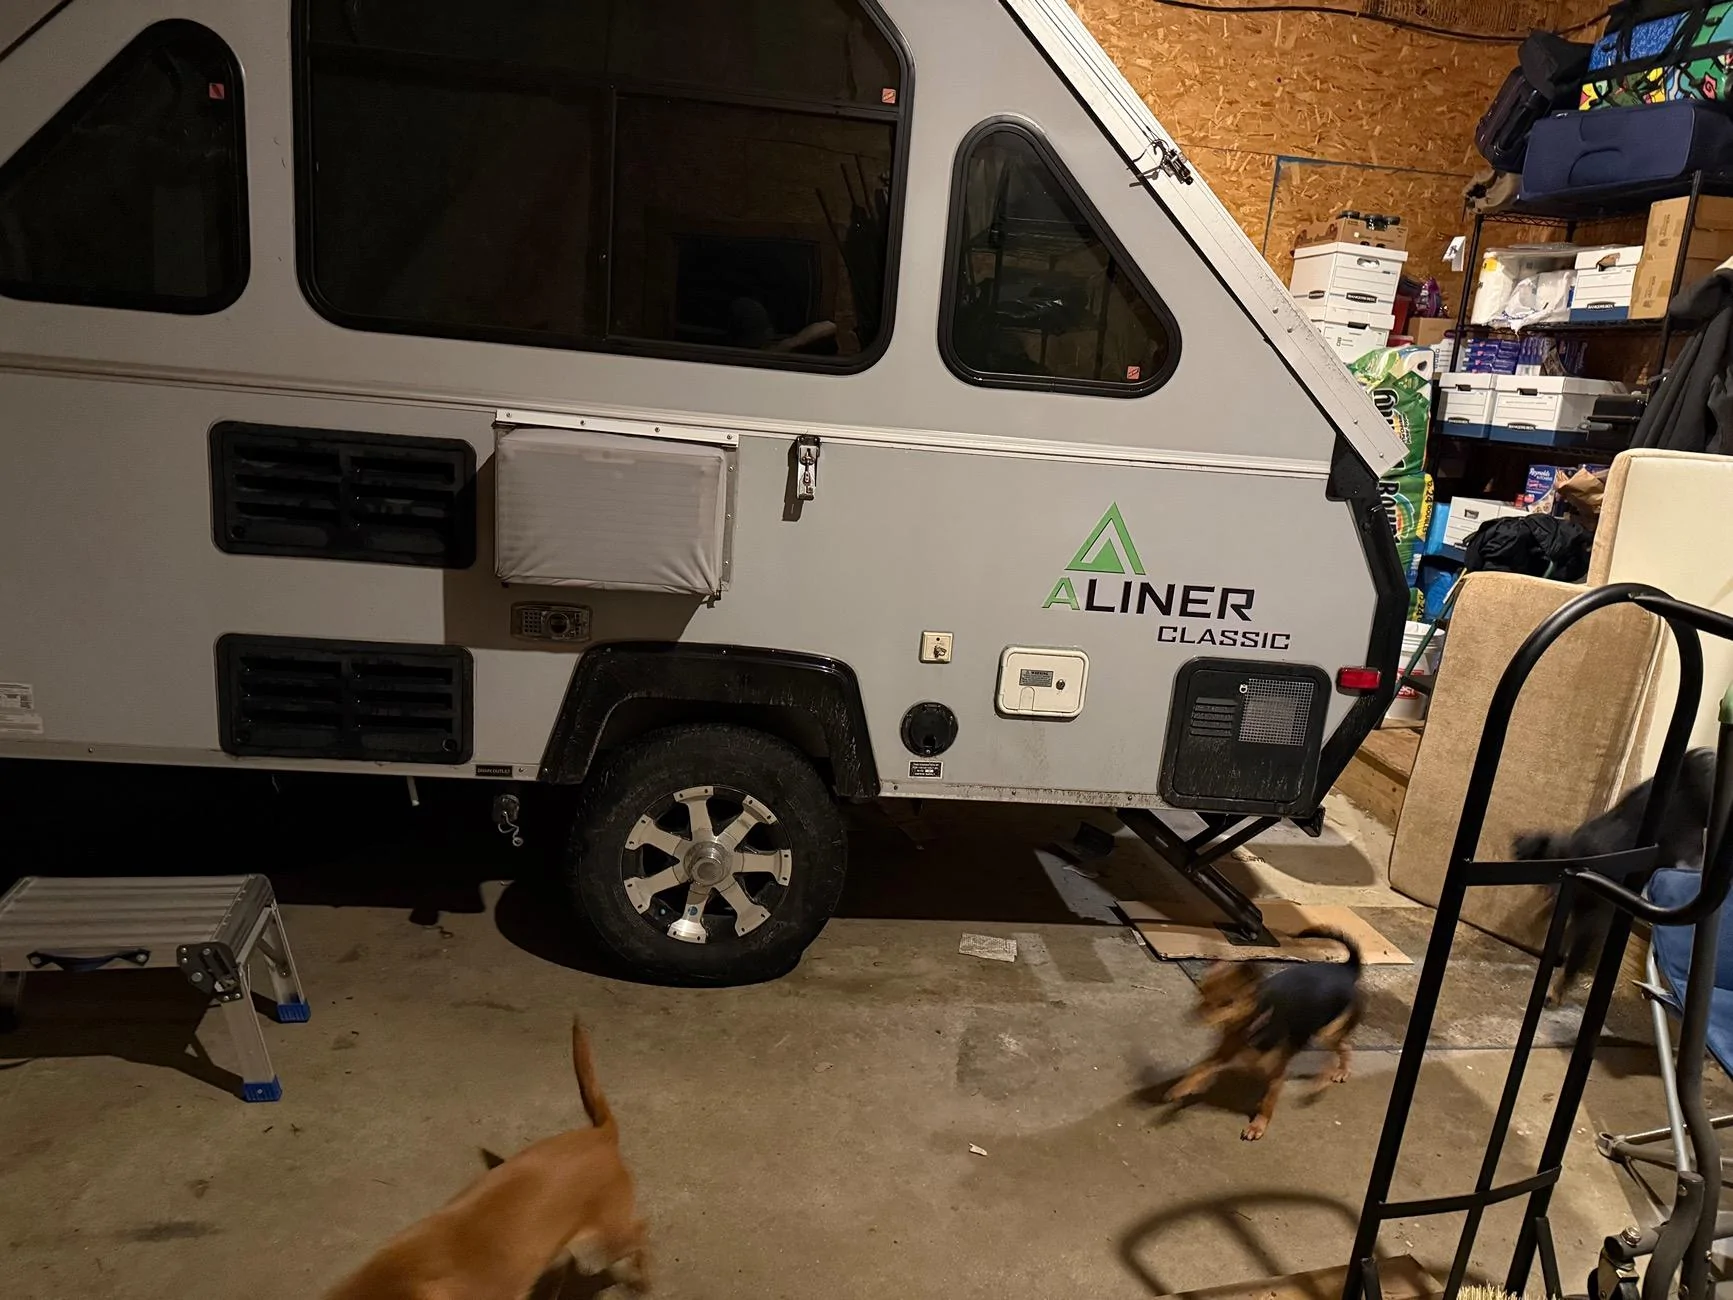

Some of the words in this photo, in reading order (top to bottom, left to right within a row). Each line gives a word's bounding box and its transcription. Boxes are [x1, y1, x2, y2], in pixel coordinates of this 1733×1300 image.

[1529, 467, 1551, 477] Reynolds
[1041, 576, 1255, 621] ALINER
[1157, 625, 1290, 650] CLASSIC
